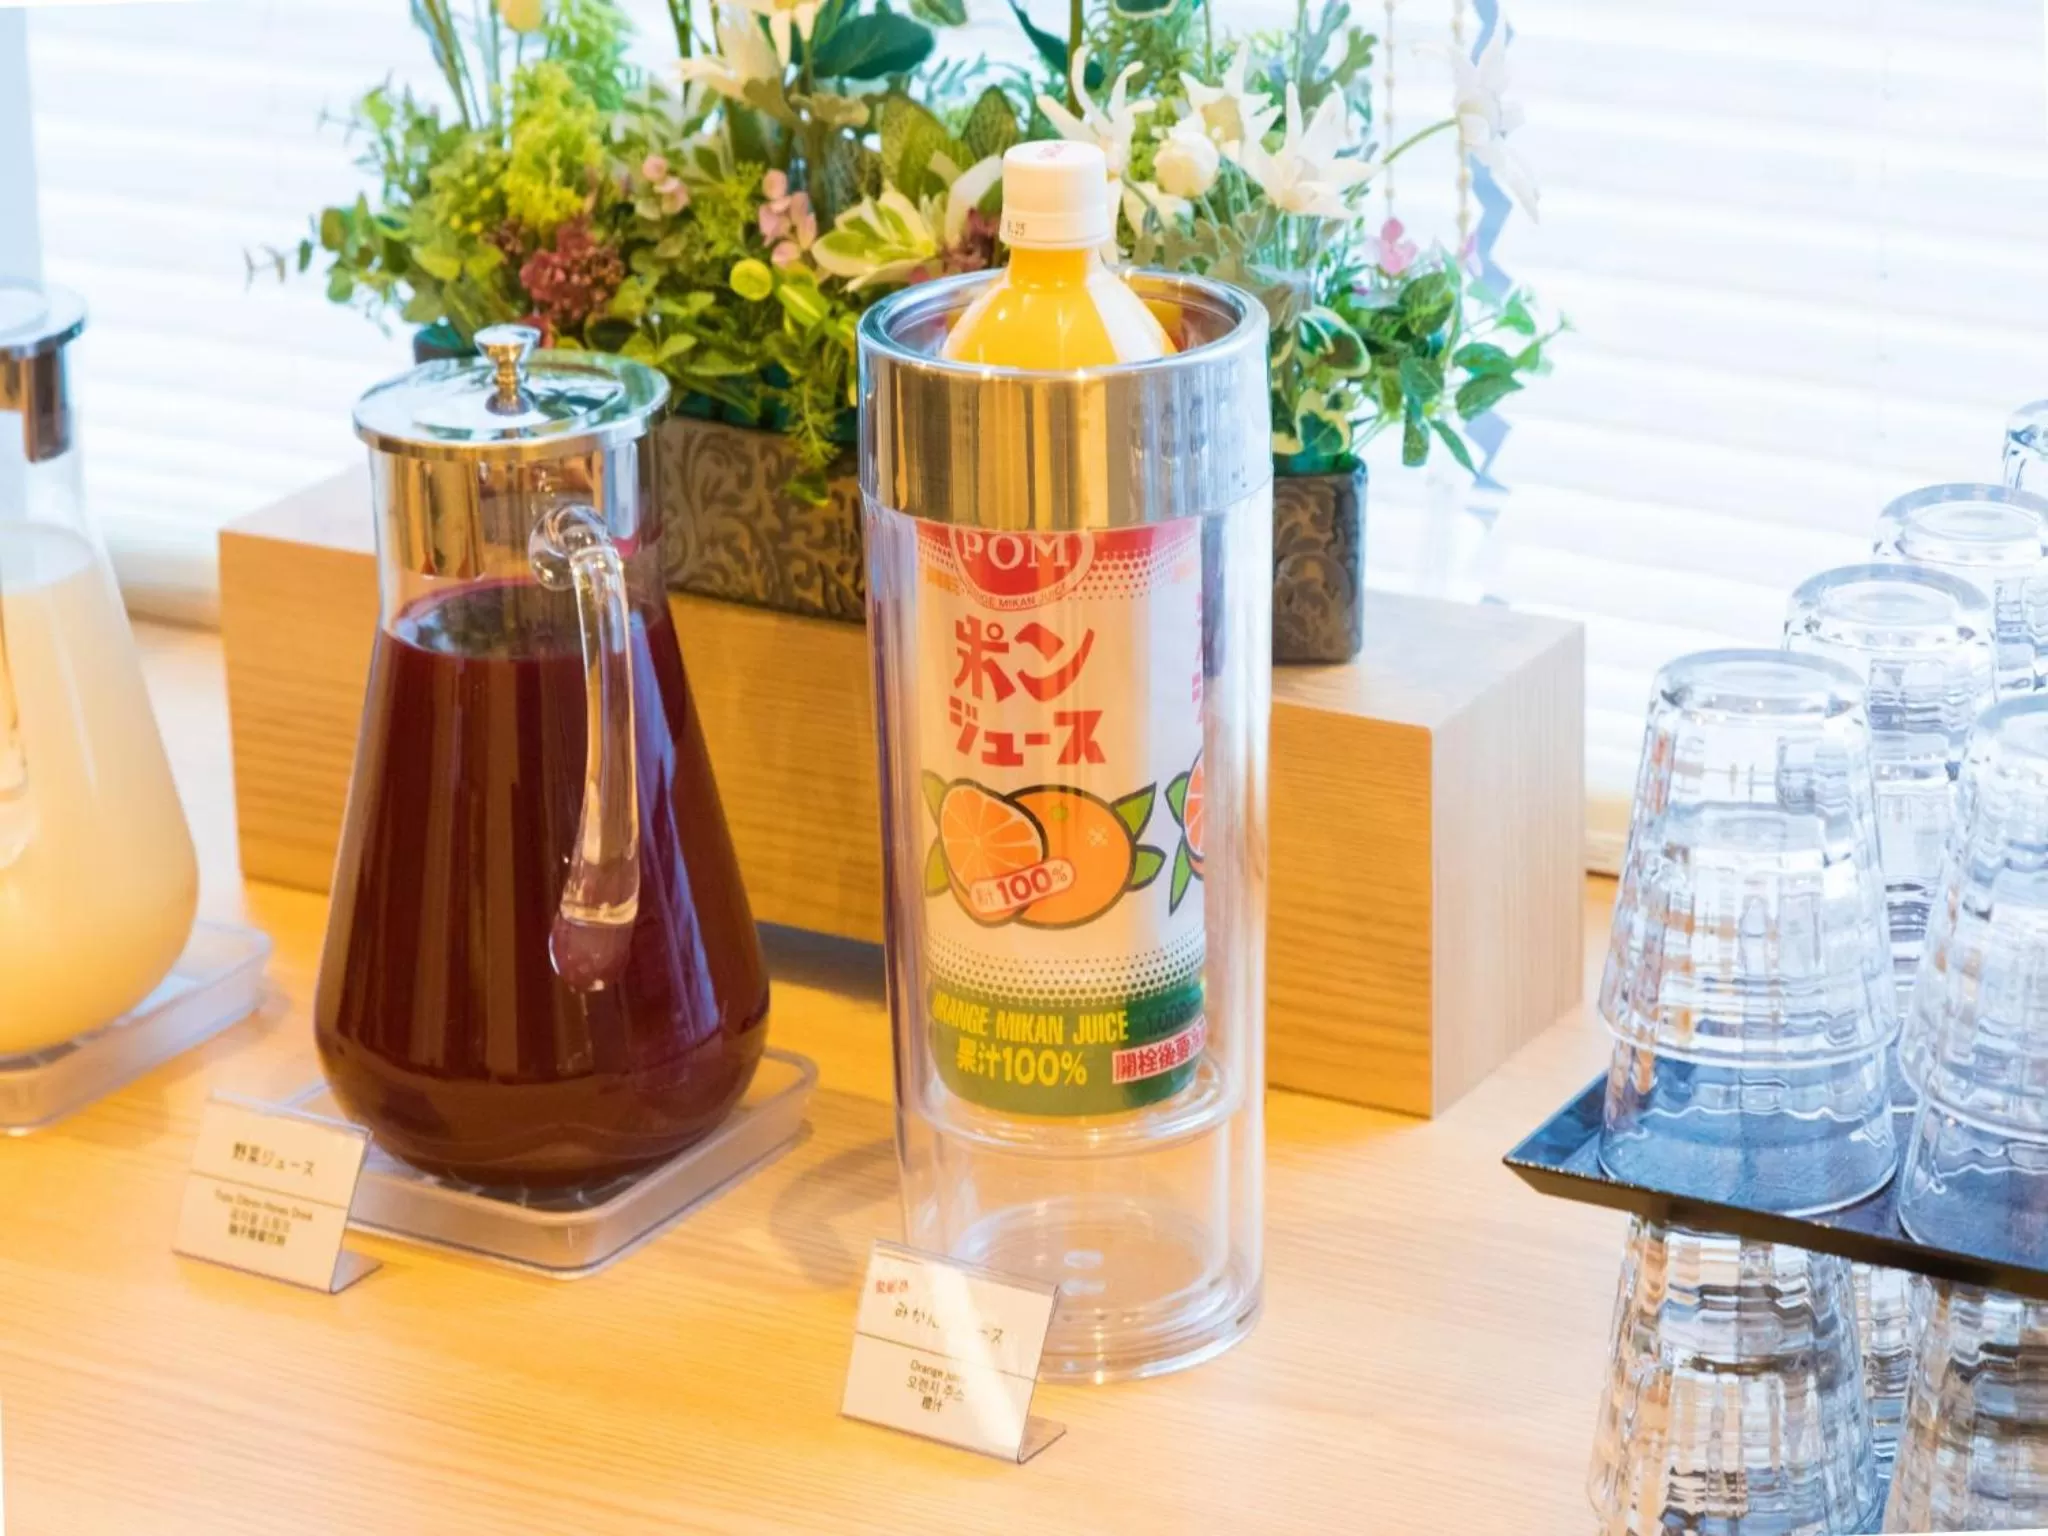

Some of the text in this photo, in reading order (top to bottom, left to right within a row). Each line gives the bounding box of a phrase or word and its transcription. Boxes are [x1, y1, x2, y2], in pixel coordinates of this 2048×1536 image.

[961, 532, 1070, 570] POM
[954, 614, 1095, 702] ポン
[948, 696, 1106, 767] ジュース
[996, 1010, 1063, 1045] MIKAN
[1073, 1011, 1129, 1045] JUICE
[956, 1036, 1087, 1086] 果汁100%
